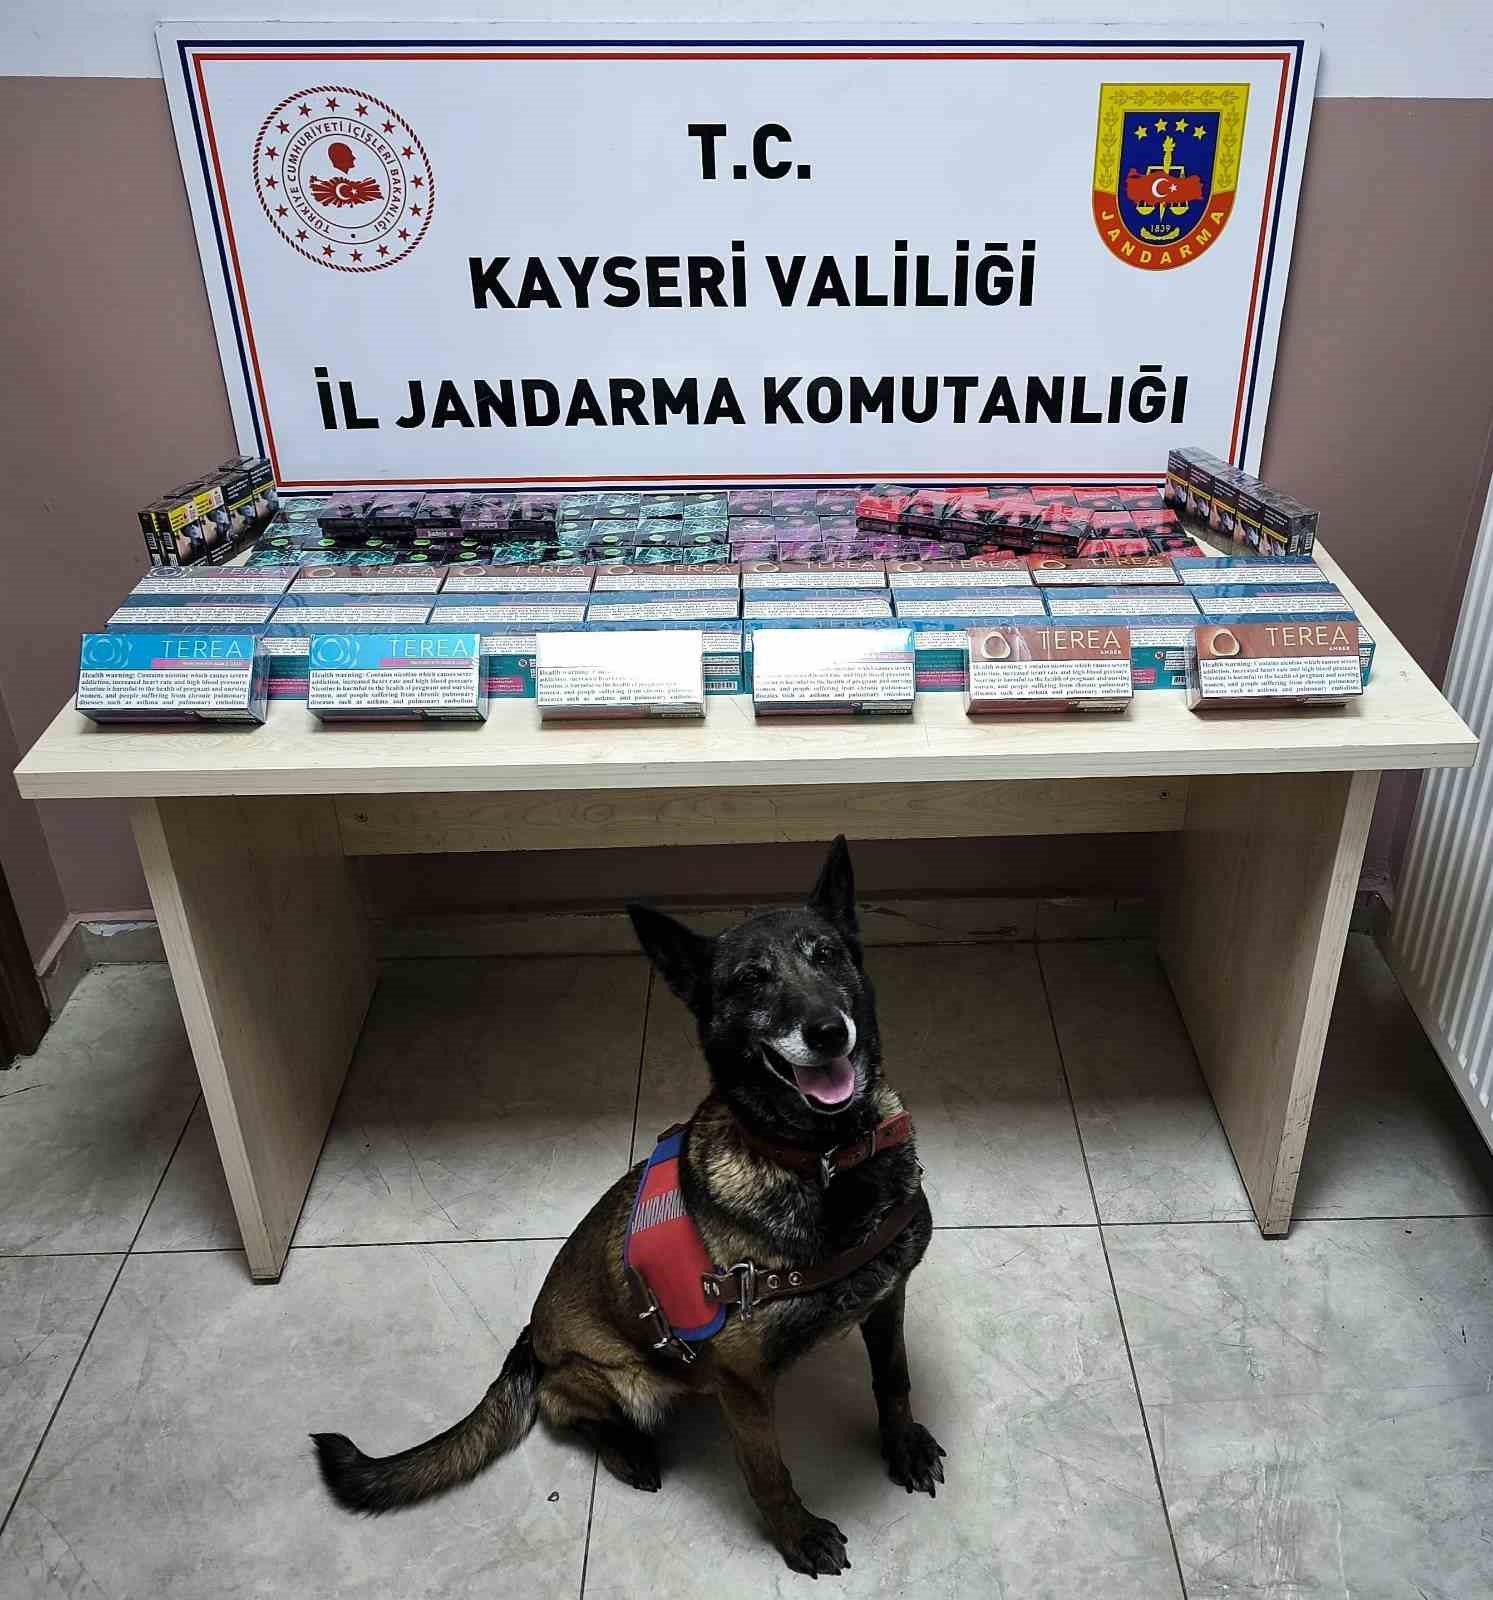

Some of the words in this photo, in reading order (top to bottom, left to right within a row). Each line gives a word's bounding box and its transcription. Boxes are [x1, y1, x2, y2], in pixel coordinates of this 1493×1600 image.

[287, 120, 343, 182] CUMHURİYETİ
[348, 122, 396, 165] İÇİŞLERİ
[688, 123, 811, 180] T.C.
[291, 186, 330, 234] TÜRKİYE
[374, 169, 402, 233] BAKANLIĞI
[1101, 210, 1225, 265] JANDARMA
[1150, 224, 1171, 233] 1839
[469, 240, 747, 309] KAYSERİ
[765, 239, 1036, 308] VALİLİĞİ
[314, 366, 380, 431] İL
[395, 377, 746, 430] JANDARMA
[763, 364, 1189, 425] KOMUTANLIĞI
[162, 640, 242, 658] TEREA
[390, 639, 470, 658] TEREA
[1037, 630, 1121, 650] TEREA
[1265, 626, 1349, 646] TEREA
